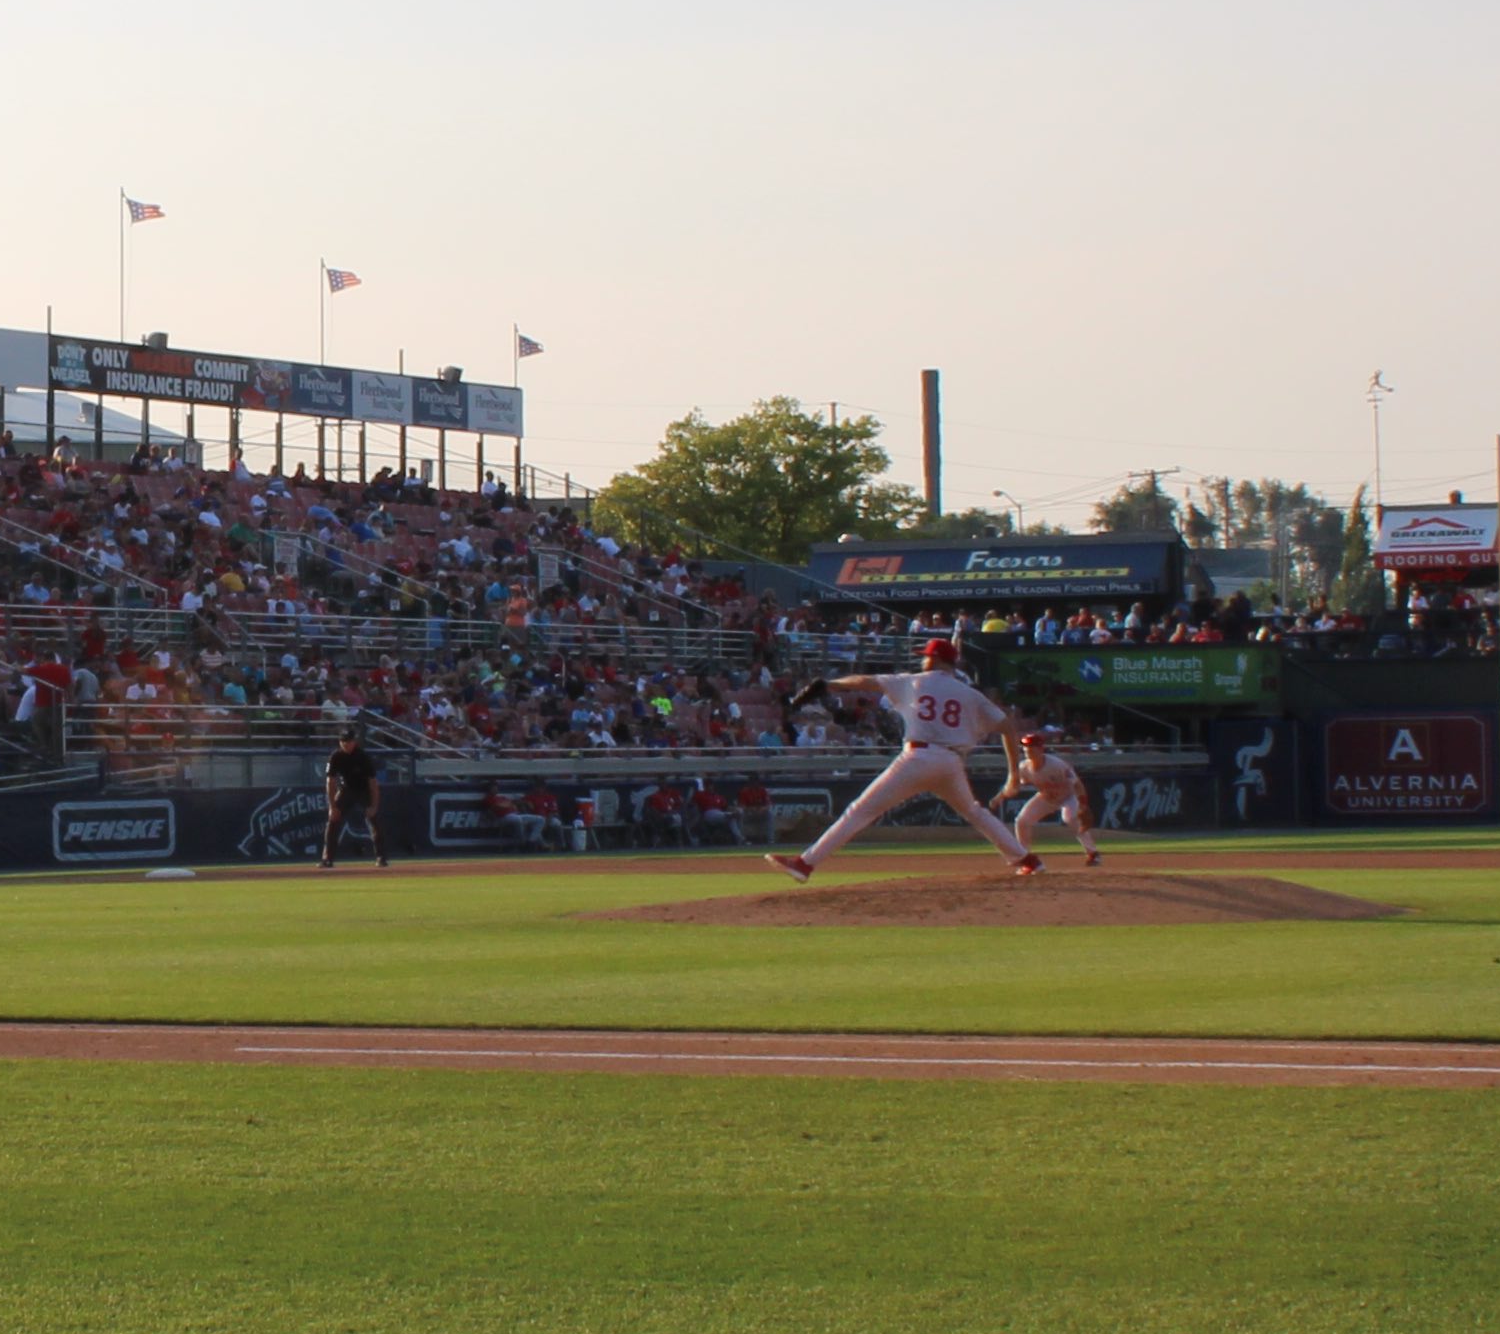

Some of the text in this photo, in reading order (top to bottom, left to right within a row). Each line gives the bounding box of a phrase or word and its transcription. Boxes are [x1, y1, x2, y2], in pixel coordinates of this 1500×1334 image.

[92, 346, 249, 382] ONLY COMMIT
[50, 365, 92, 385] WEASEL
[299, 372, 343, 393] Fleetwood
[106, 370, 234, 402] INSURANCE FRAUD!
[360, 379, 400, 397] Fleetwood
[419, 387, 460, 406] Fleetwood
[475, 393, 513, 411] Fleetwood
[1390, 528, 1486, 539] GREENAWALT
[1113, 656, 1203, 671] Blue Marsh
[1113, 671, 1203, 685] INSURANCE
[917, 695, 963, 729] 38
[1333, 774, 1479, 792] ALVERNIA
[1102, 777, 1183, 831] R-Phils
[1347, 795, 1466, 808] UNIVERSITY
[63, 819, 165, 843] PENSKE
